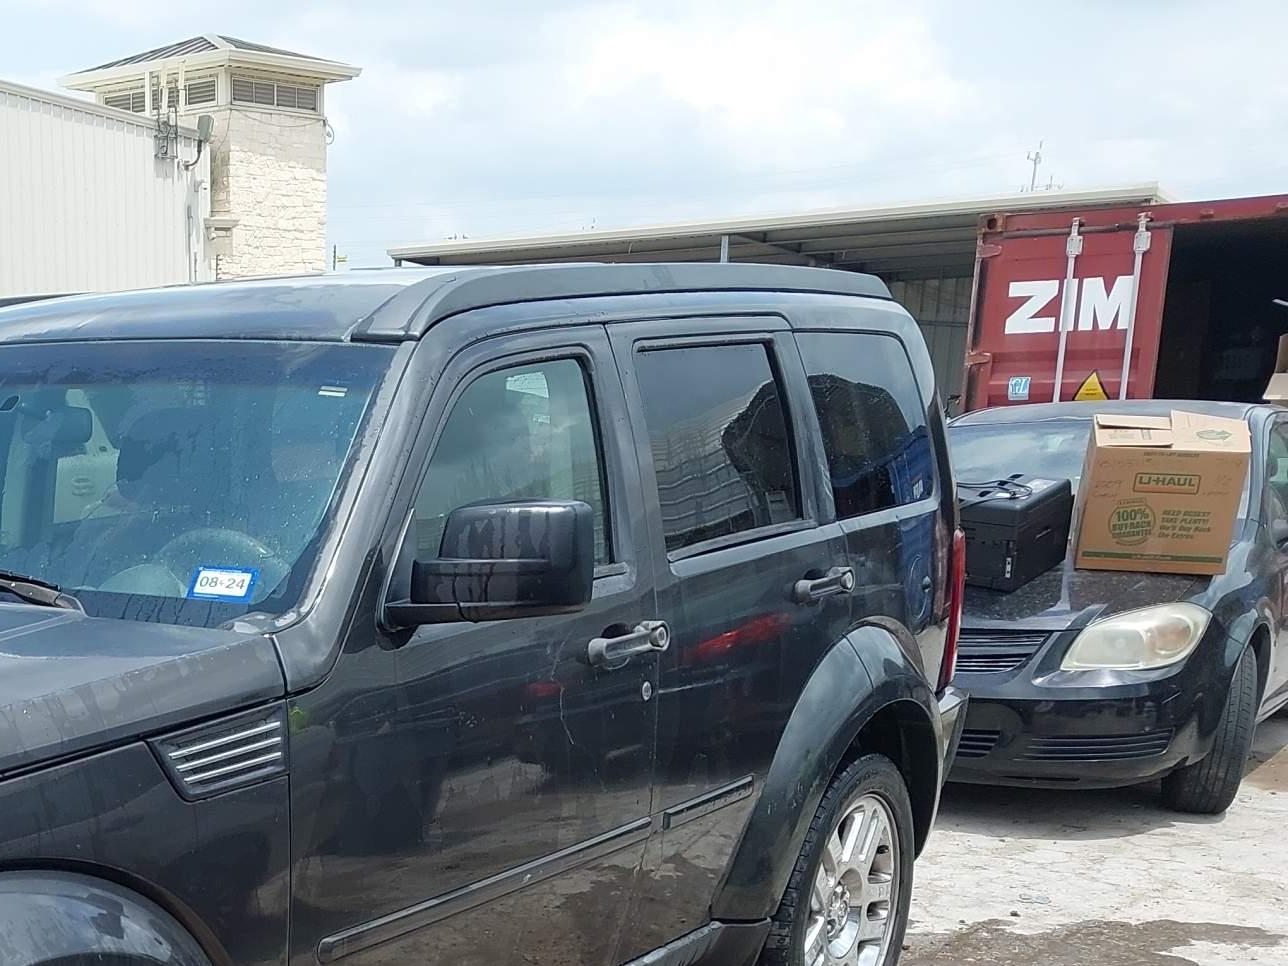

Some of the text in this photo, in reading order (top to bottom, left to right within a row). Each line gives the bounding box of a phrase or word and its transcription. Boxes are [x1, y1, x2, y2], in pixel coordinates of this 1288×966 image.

[1004, 275, 1136, 335] ZIM
[1138, 475, 1196, 487] U-HAUL
[1116, 508, 1150, 522] 100%
